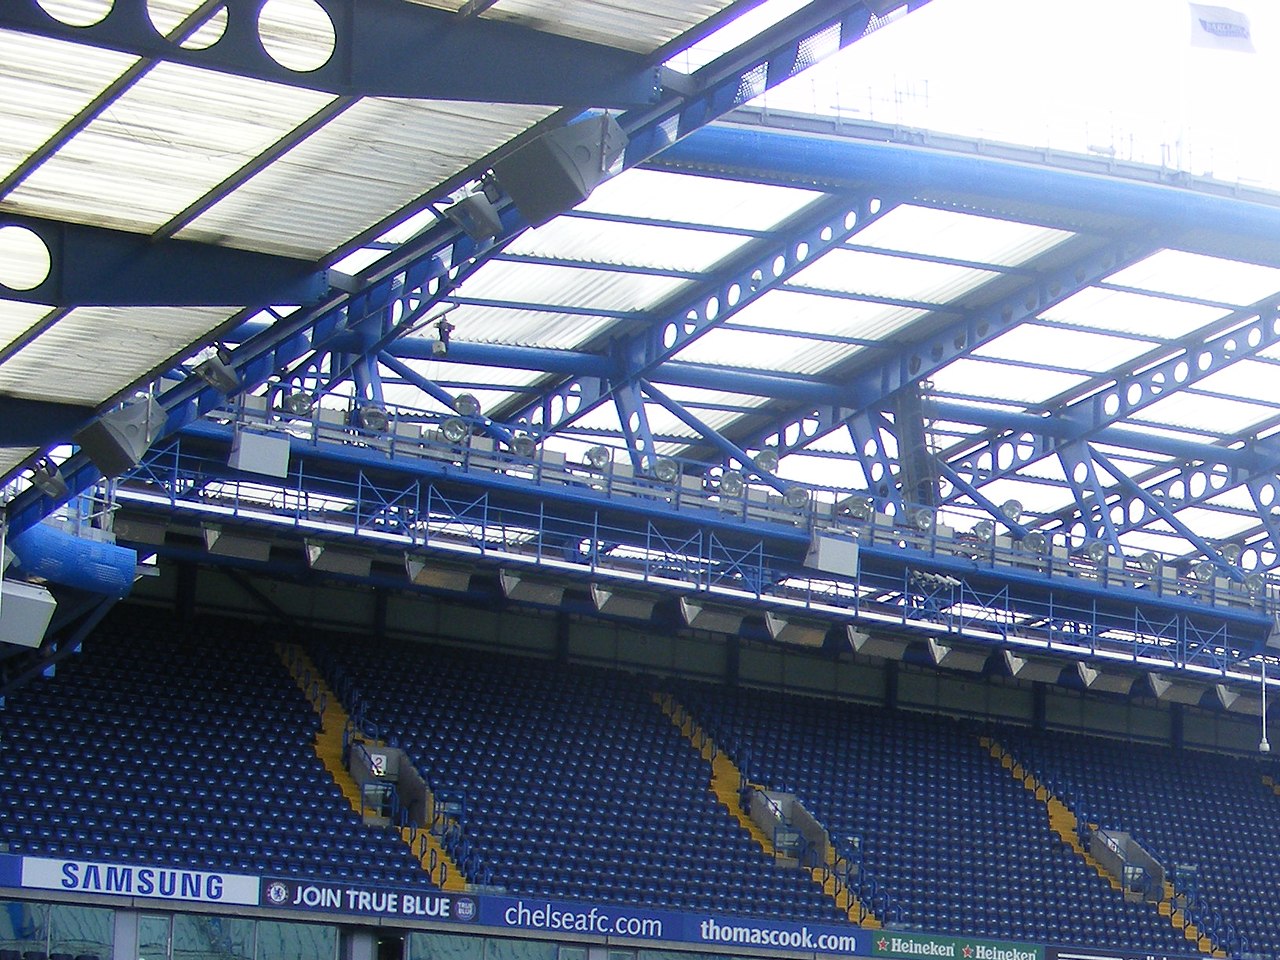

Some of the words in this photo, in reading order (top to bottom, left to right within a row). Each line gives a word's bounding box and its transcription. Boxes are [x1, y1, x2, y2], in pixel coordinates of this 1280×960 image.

[61, 862, 223, 899] SAMSUNG
[293, 886, 341, 908] JOIN
[347, 892, 399, 912] TRUE
[402, 895, 450, 917] BLUE
[505, 902, 662, 937] chelseafc.com
[701, 921, 856, 951] thomascook.com
[891, 939, 955, 957] Heineken
